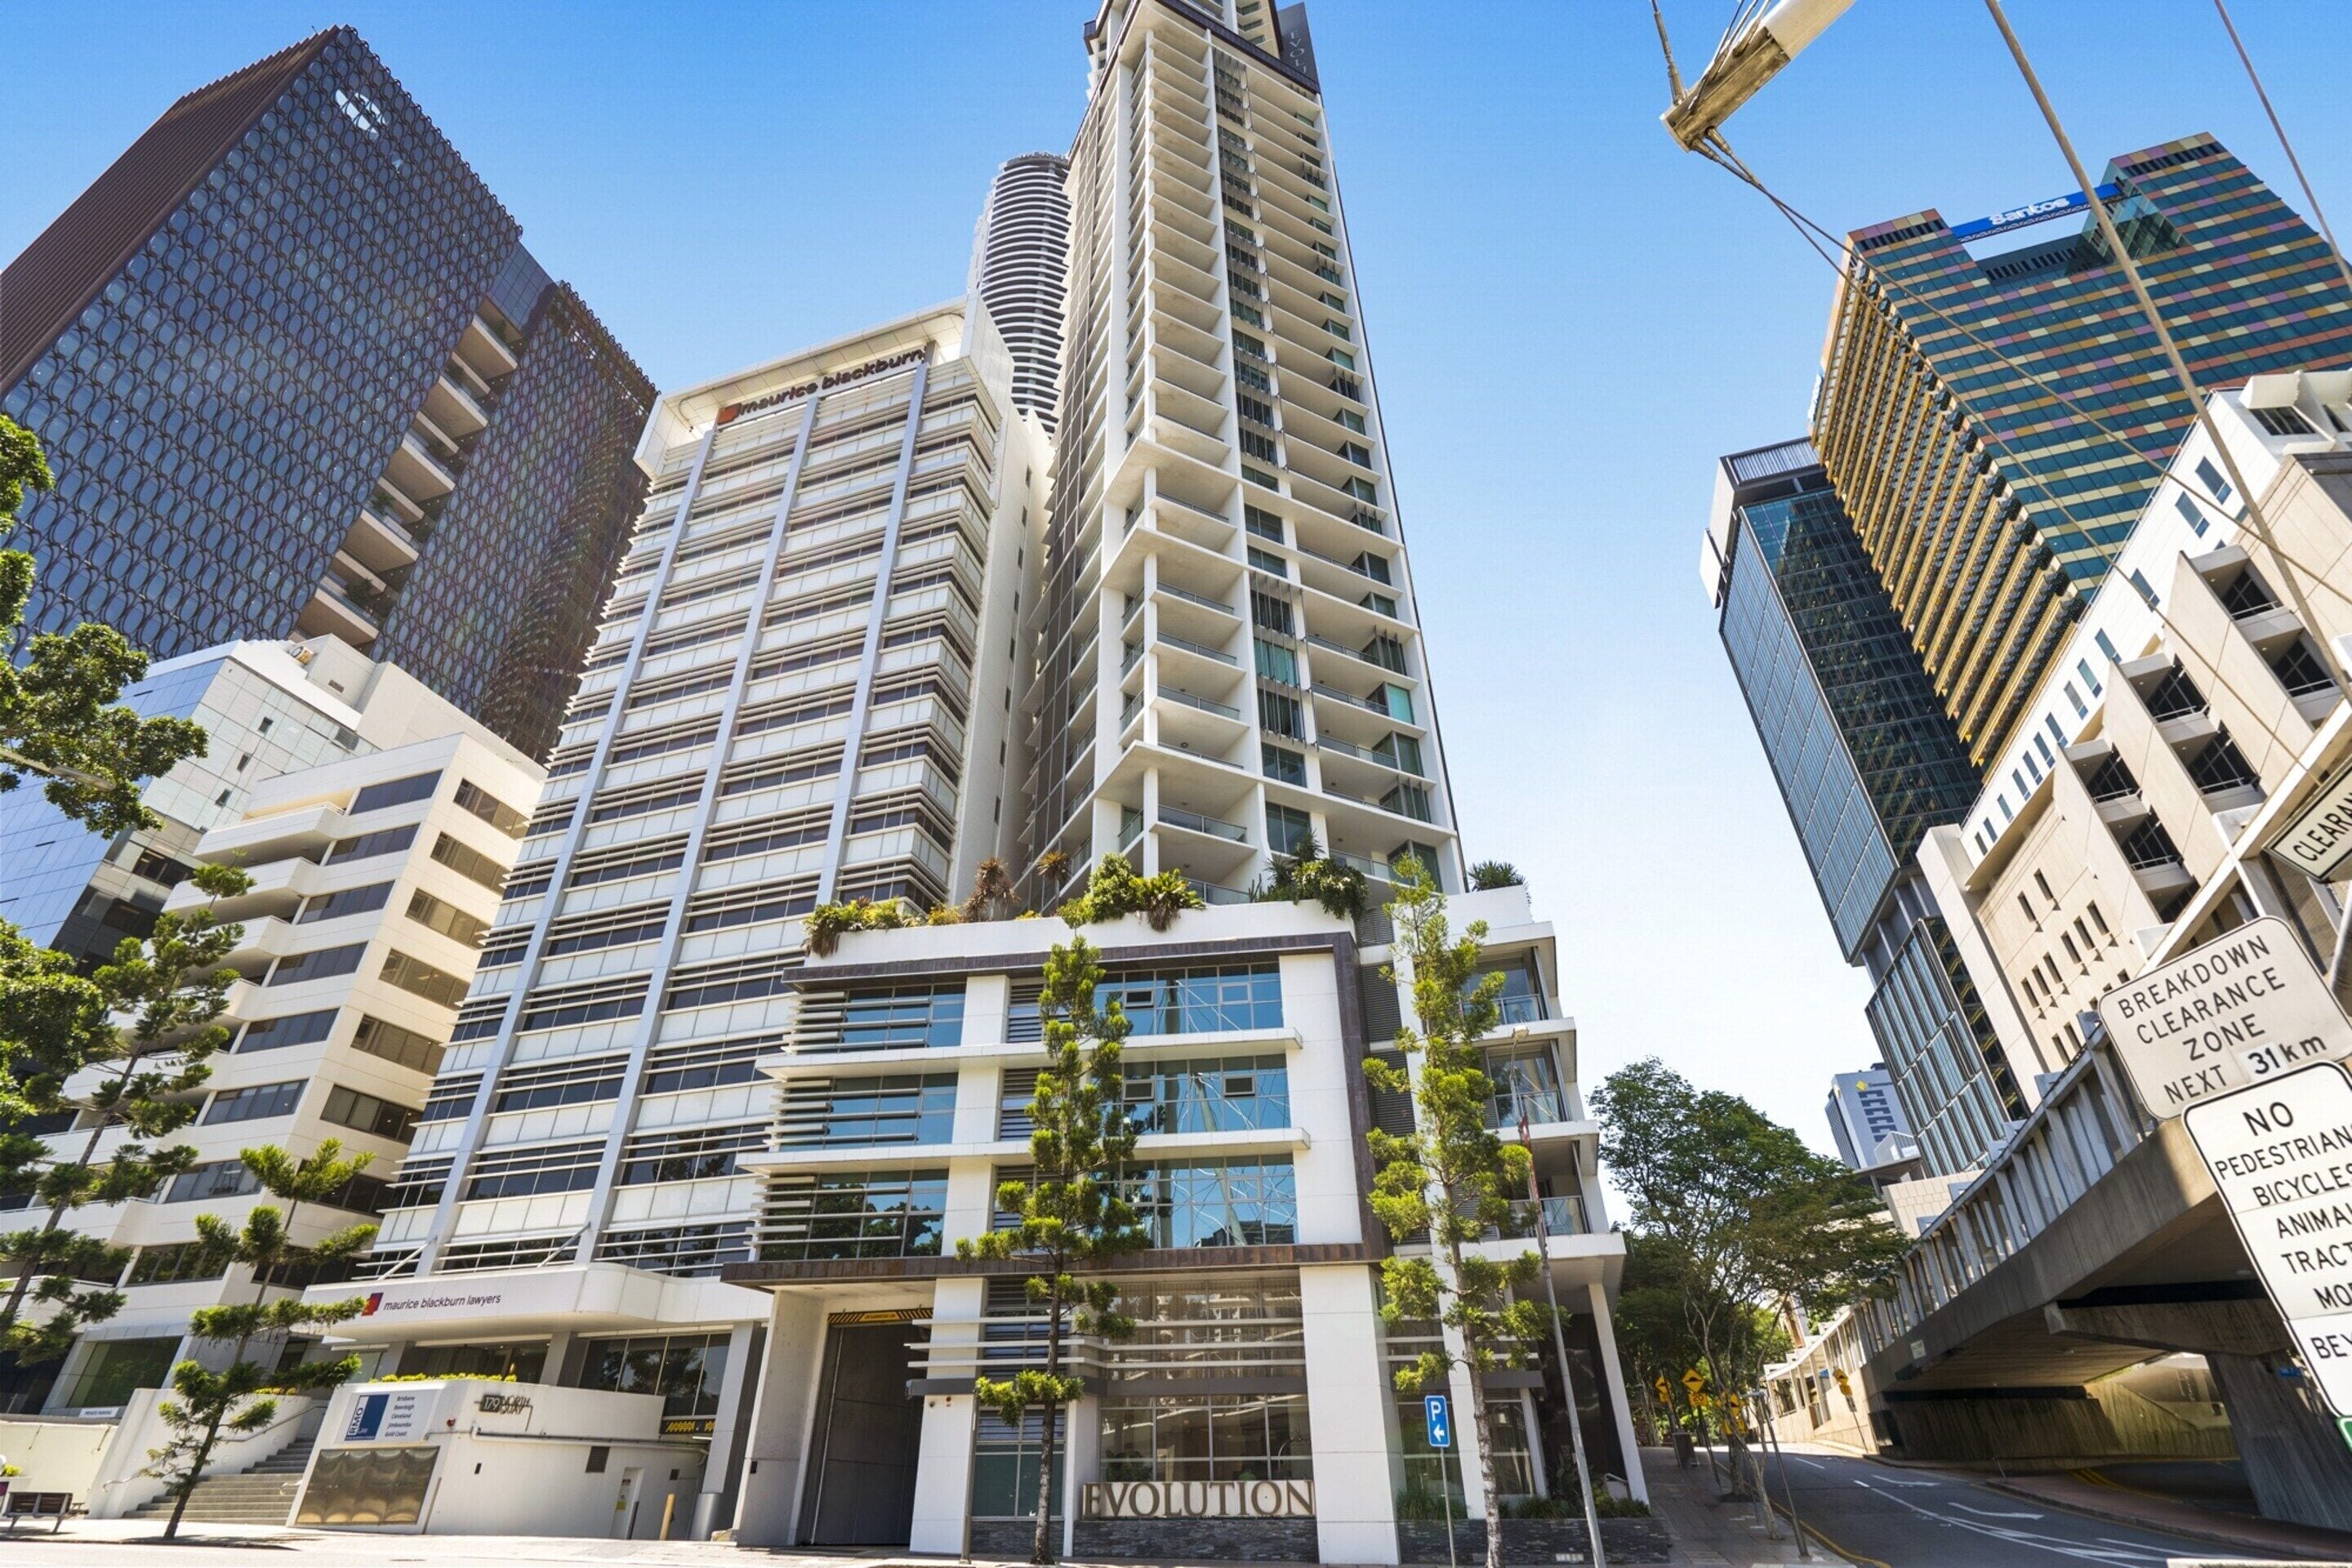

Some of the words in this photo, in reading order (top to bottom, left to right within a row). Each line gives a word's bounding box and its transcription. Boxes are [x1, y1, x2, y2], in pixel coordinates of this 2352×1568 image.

[1989, 198, 2070, 225] Santos
[738, 381, 817, 417] maurice
[822, 349, 925, 390] blackburn
[2118, 935, 2270, 1018] BREAKDOWN
[2136, 967, 2285, 1044] CLEARANCE
[2182, 1013, 2265, 1061] ZONE
[2163, 1065, 2227, 1104] NEXT
[2243, 1102, 2294, 1136] NO
[2214, 1123, 2352, 1180] PEDESTRIAN
[383, 1299, 419, 1310] maurice
[421, 1297, 465, 1308] blackburn
[467, 1294, 501, 1307] lawyers
[350, 1407, 363, 1434] RMO
[483, 1396, 501, 1410] 179
[1431, 1401, 1441, 1421] P
[1085, 1481, 1315, 1517] EVOLUTION
